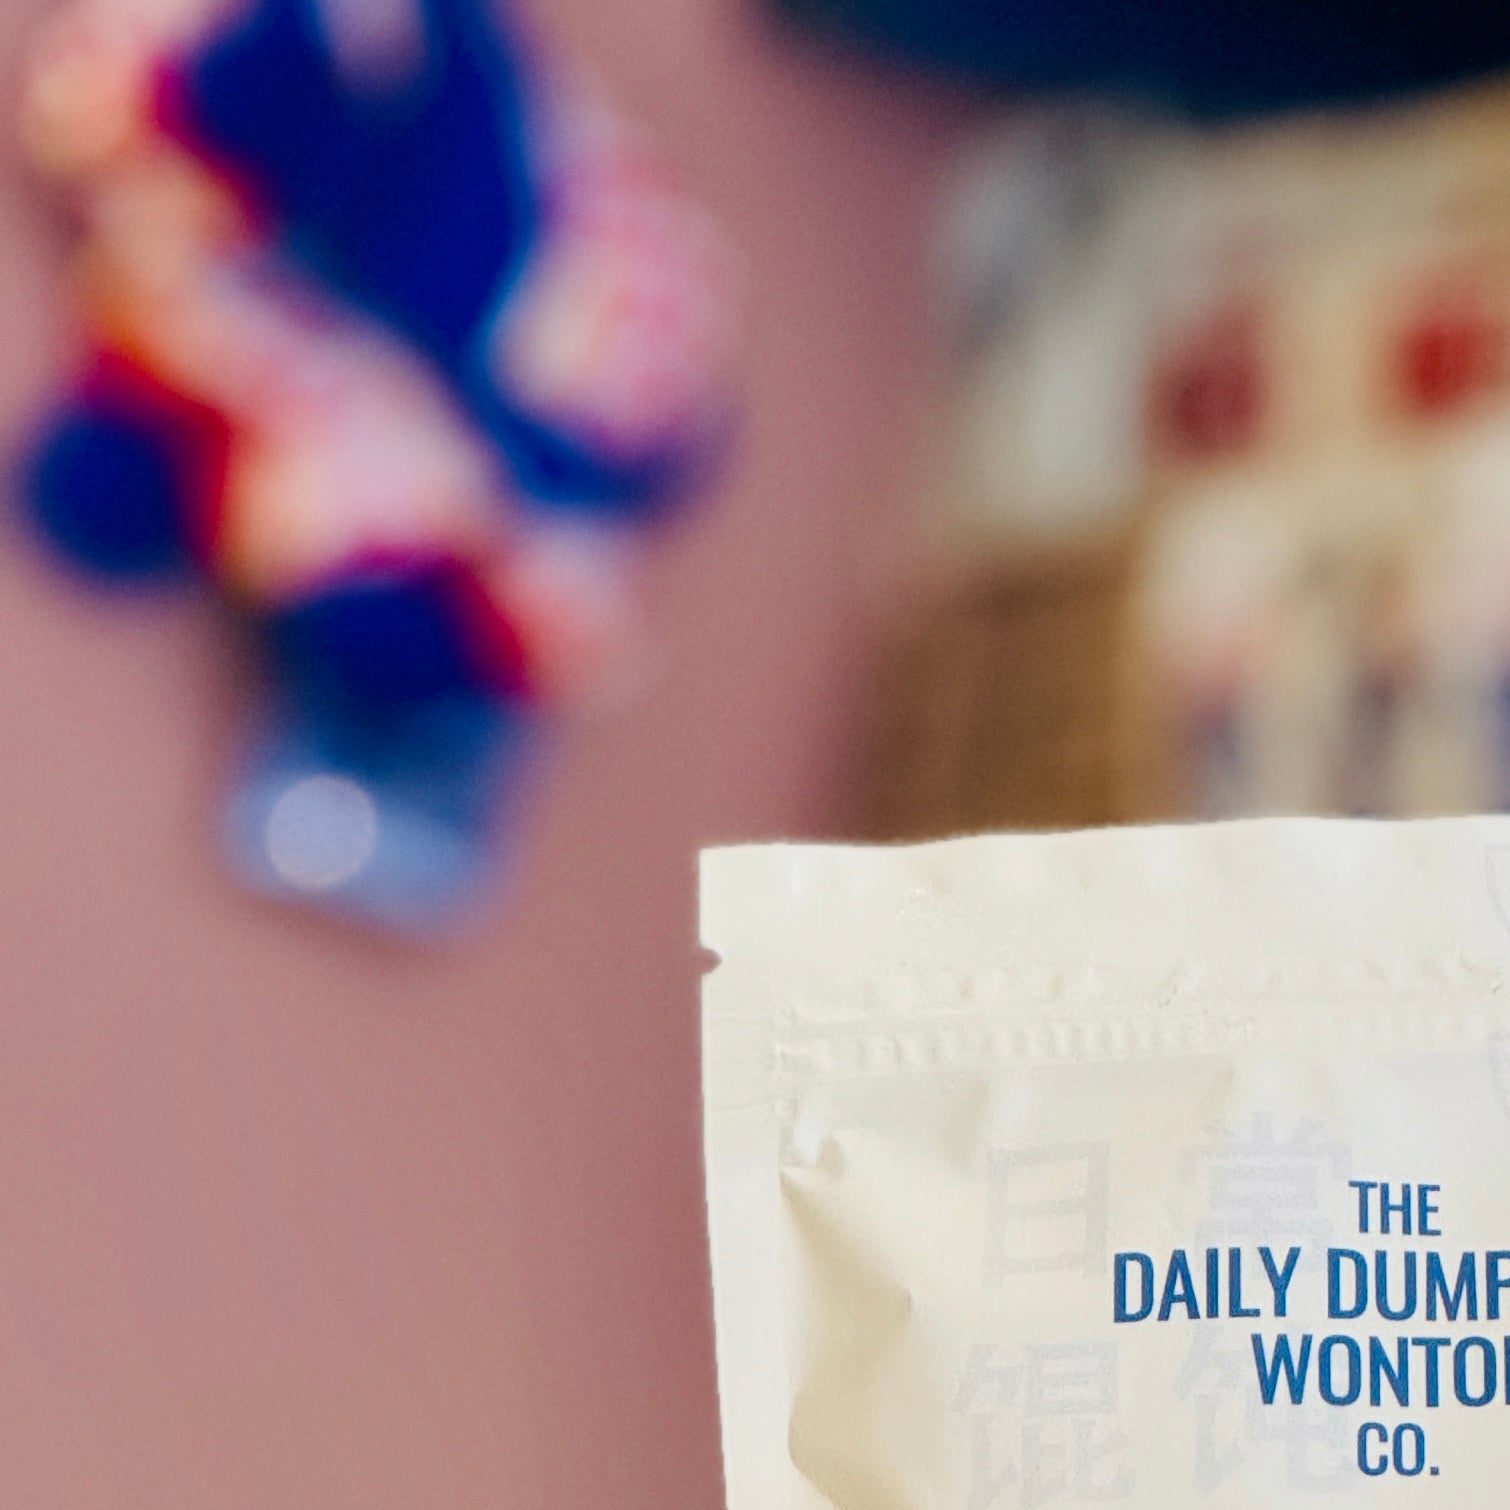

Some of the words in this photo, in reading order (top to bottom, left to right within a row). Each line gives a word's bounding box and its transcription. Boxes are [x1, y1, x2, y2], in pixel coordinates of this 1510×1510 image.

[1348, 1180, 1442, 1237] THE
[1113, 1246, 1302, 1324] DAILY
[1356, 1421, 1440, 1477] CO.
